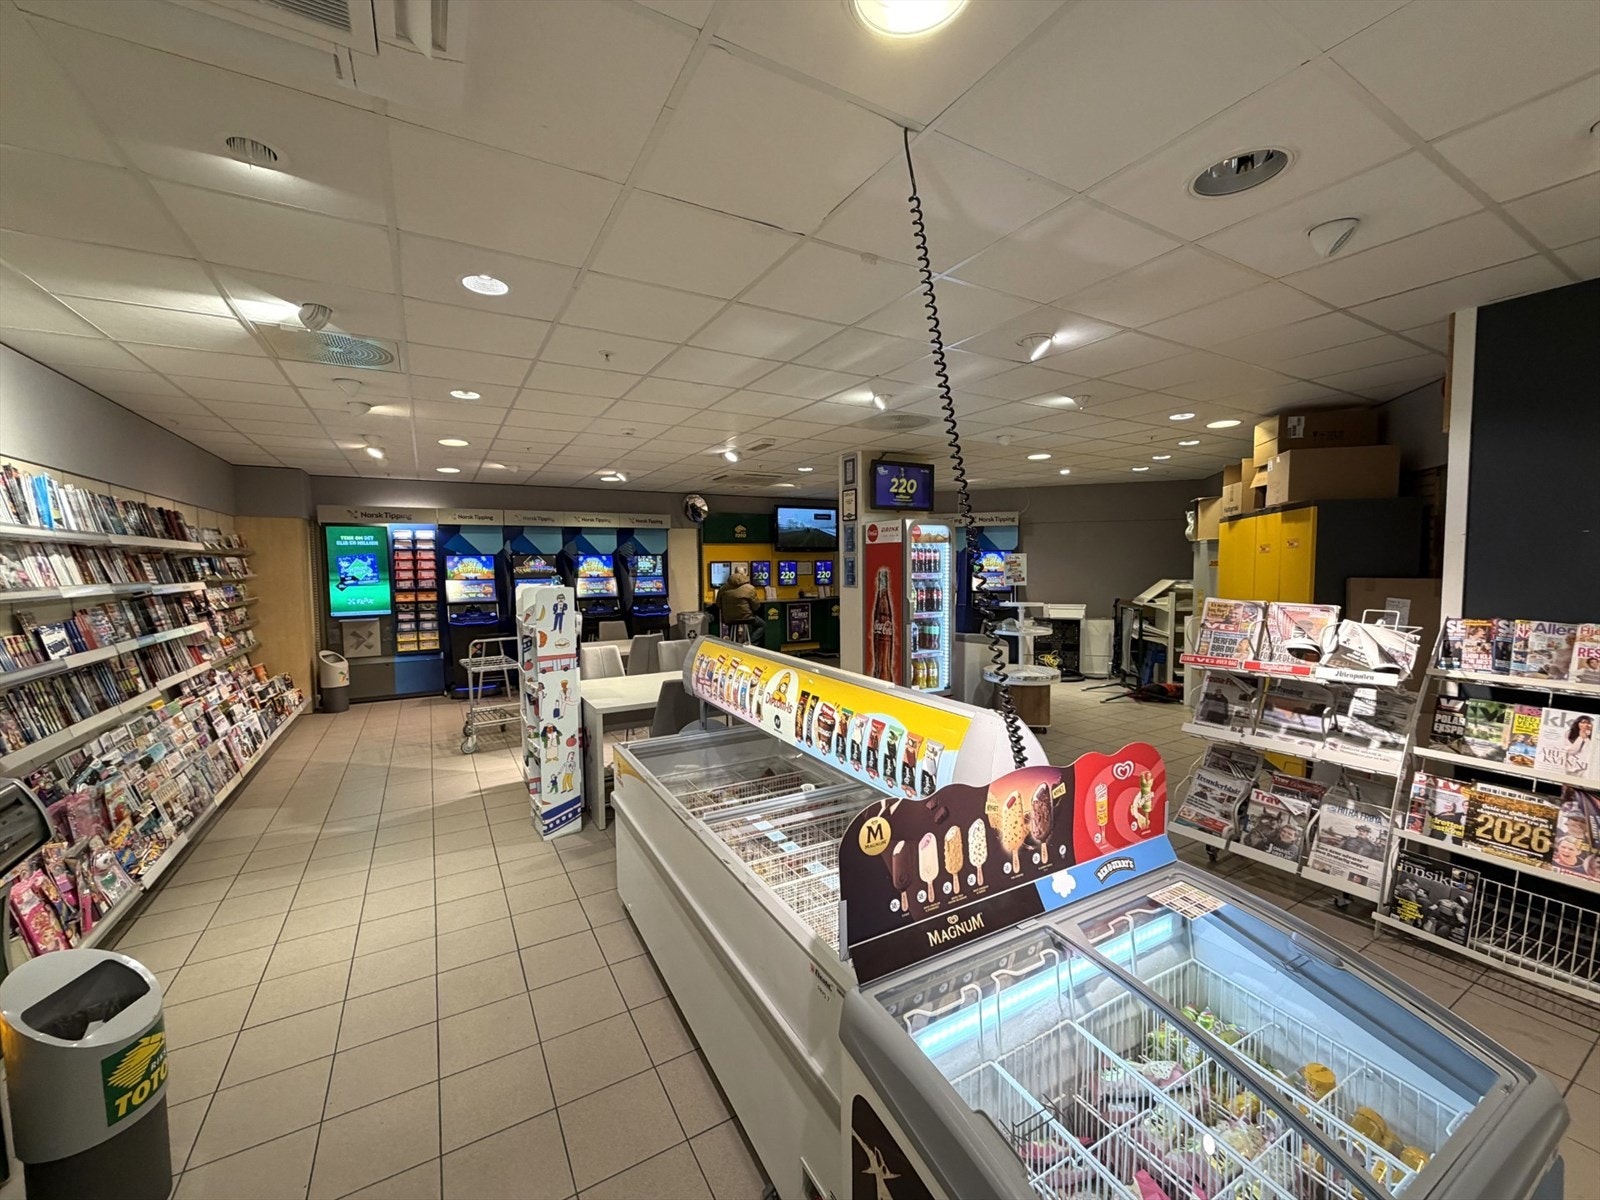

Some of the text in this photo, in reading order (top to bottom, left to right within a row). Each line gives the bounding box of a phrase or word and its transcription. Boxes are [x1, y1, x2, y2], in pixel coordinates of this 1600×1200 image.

[890, 478, 917, 494] 220
[384, 512, 412, 520] Tipping
[1205, 622, 1235, 630] VG
[1213, 636, 1238, 646] DERFOR
[1335, 671, 1374, 680] Aftenposten
[1435, 713, 1466, 725] POLAR
[1434, 722, 1464, 734] EKSPR
[1254, 791, 1280, 805] Trav
[1336, 806, 1382, 824] HITRA FRØYA
[867, 824, 884, 843] M
[1476, 815, 1551, 854] 2026
[865, 840, 886, 849] MAGNUM
[1400, 860, 1457, 888] innsikt
[927, 913, 985, 947] MAGNUM
[115, 1058, 168, 1117] TOTO
